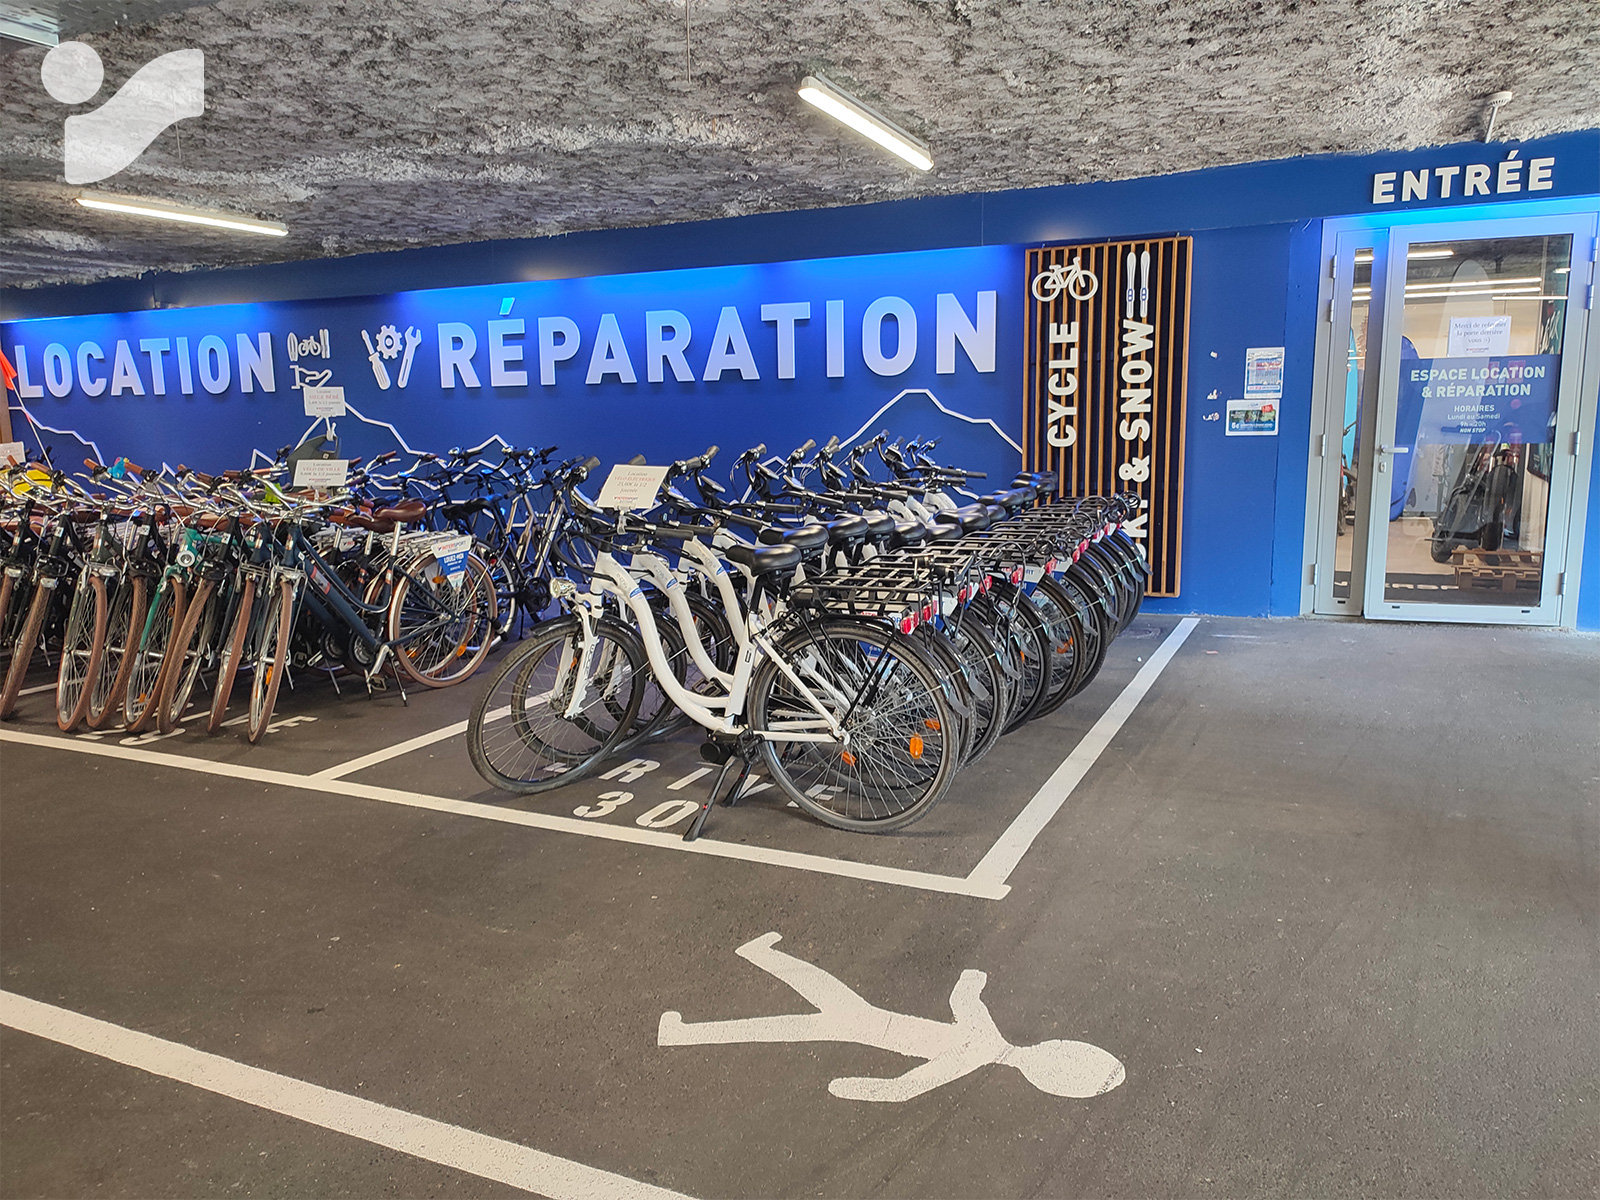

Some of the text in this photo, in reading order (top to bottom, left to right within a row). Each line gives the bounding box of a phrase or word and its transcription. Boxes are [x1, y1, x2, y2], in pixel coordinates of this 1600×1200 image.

[1372, 150, 1555, 204] ENTRÉE
[437, 290, 997, 388] RÉPARATION
[14, 332, 276, 398] LOCATION
[1047, 321, 1079, 448] CYCLE
[1119, 319, 1154, 443] SNOW
[1410, 366, 1545, 382] ESPACE LOCATION
[1421, 382, 1531, 398] & RÉPARATION
[1454, 404, 1495, 412] HORAIRES
[1119, 455, 1150, 483] &
[572, 791, 700, 828] 30
